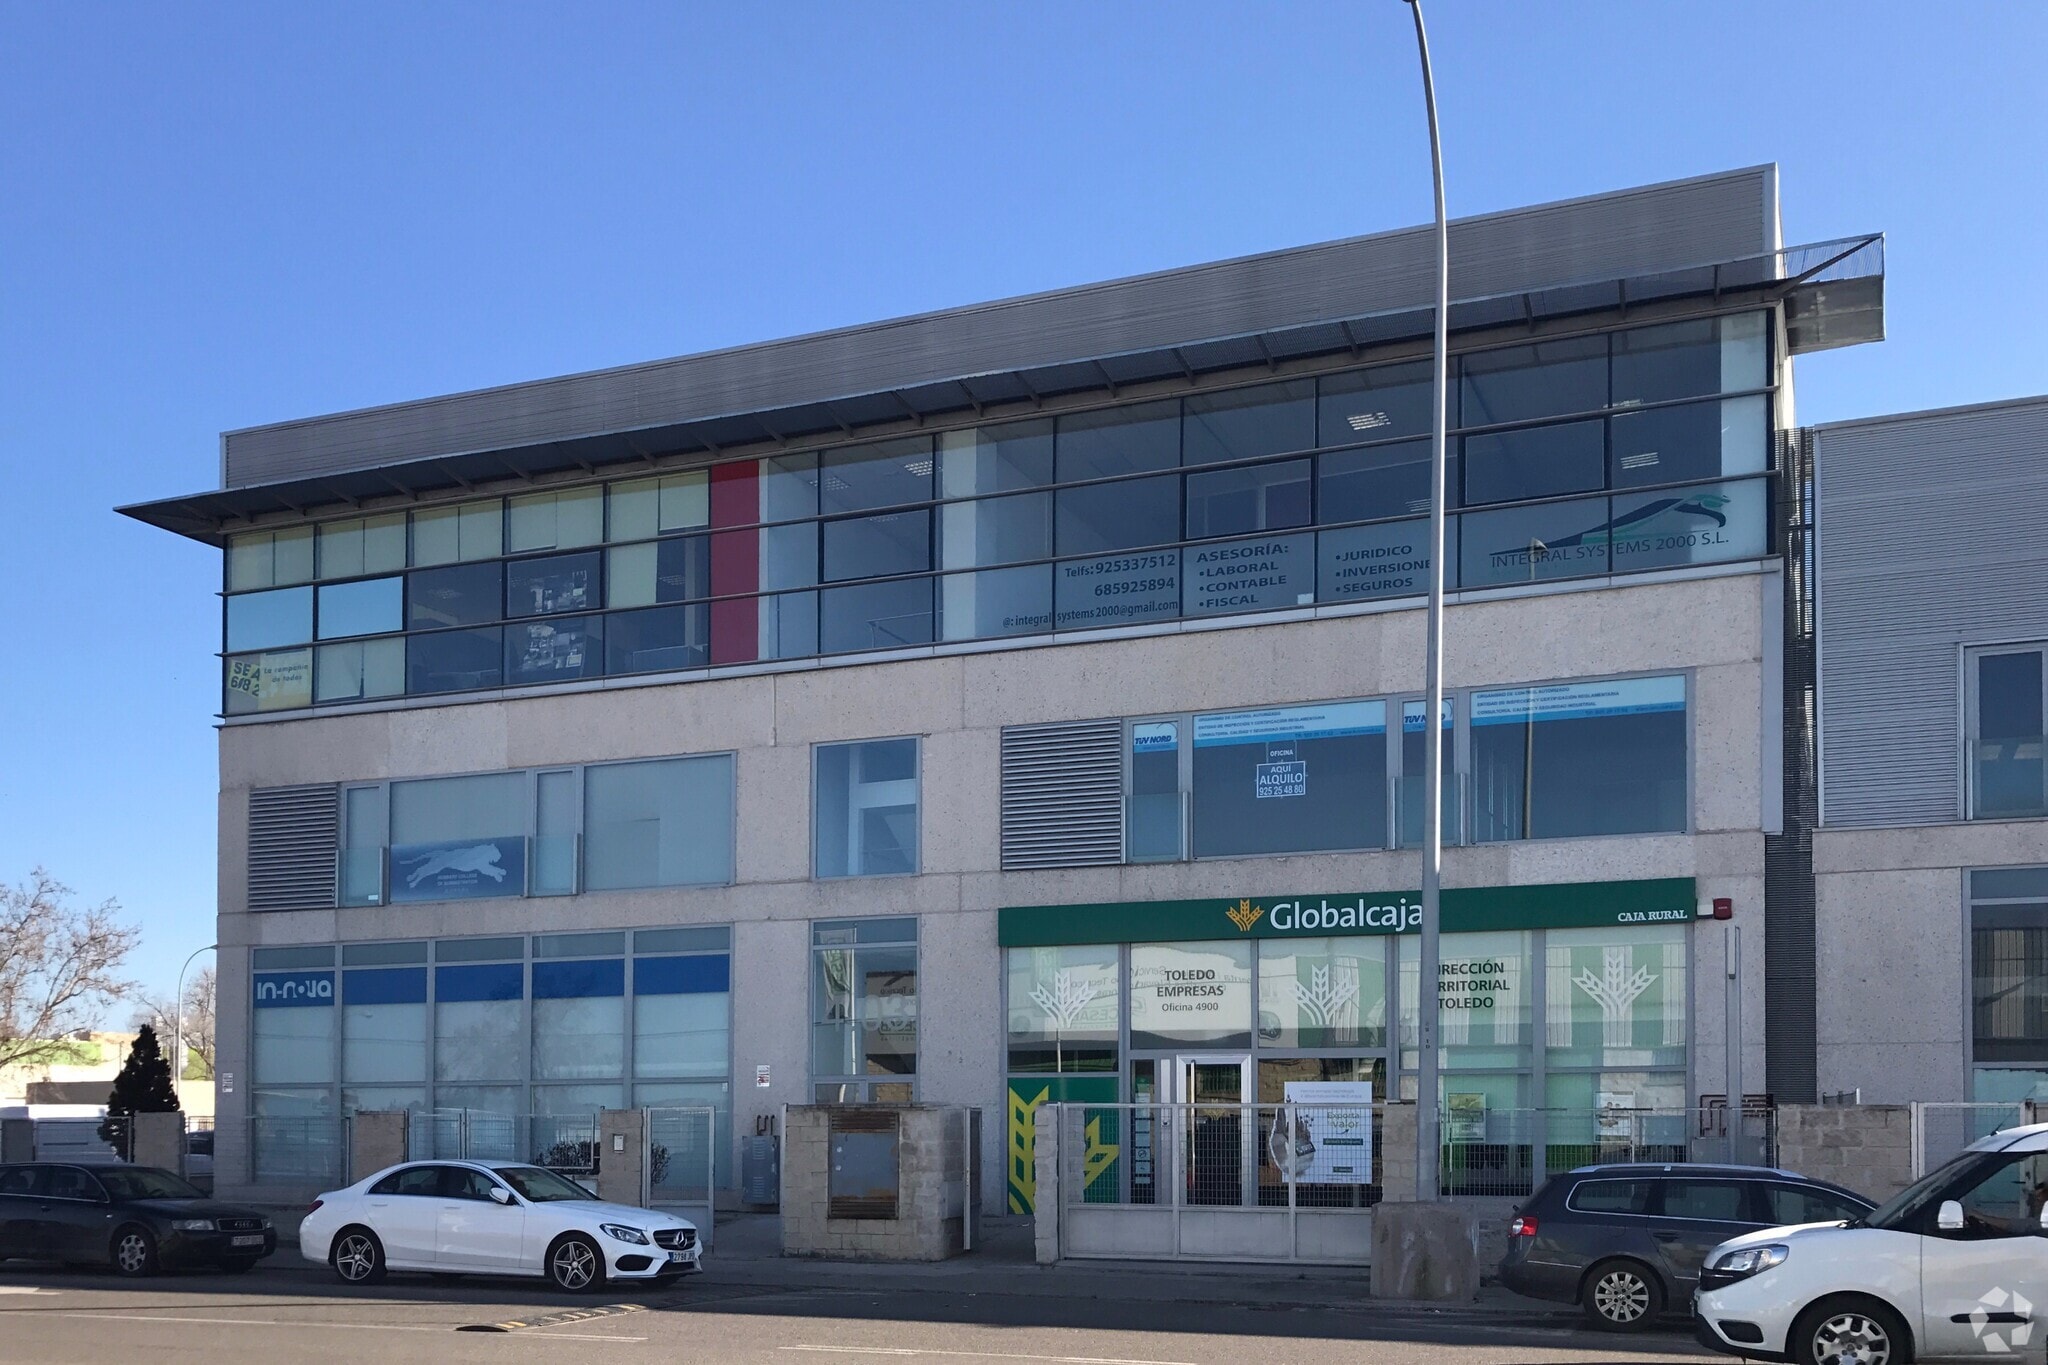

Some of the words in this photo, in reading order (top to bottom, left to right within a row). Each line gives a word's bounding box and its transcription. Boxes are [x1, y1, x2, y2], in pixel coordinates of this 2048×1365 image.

[1196, 543, 1288, 563] ASESORÍA:
[1342, 545, 1412, 561] JURIDICO
[1491, 551, 1570, 568] INTEGRAL
[1576, 540, 1650, 559] SYSTEMS
[1656, 534, 1696, 550] 2000
[1701, 531, 1729, 545] S.L.
[1095, 554, 1175, 574] 925337512
[1207, 561, 1279, 577] LABORAL
[1343, 559, 1430, 578] INVERSIONE
[1094, 577, 1175, 596] 685925894
[1206, 575, 1287, 592] CONTABLE
[1343, 577, 1413, 593] SEGUROS
[1206, 594, 1259, 608] FISCAL
[1150, 735, 1172, 744] NORD
[1270, 749, 1294, 757] OFICINA
[1260, 772, 1303, 785] ALQUILO
[1259, 786, 1273, 796] 925
[1273, 786, 1283, 795] 25
[1283, 785, 1293, 794] 48
[1270, 898, 1422, 932] Globalcaja
[1617, 912, 1647, 922] CAJA
[1647, 909, 1687, 920] RURAL
[1438, 959, 1504, 975] IRECCIÓN
[1164, 969, 1215, 981] TOLEDO
[1157, 985, 1224, 997] EMPRESAS
[1438, 979, 1510, 992] RRITORIAL
[1162, 1003, 1193, 1011] Oficina
[1195, 1002, 1219, 1011] 4900
[1438, 997, 1494, 1009] TOLEDO
